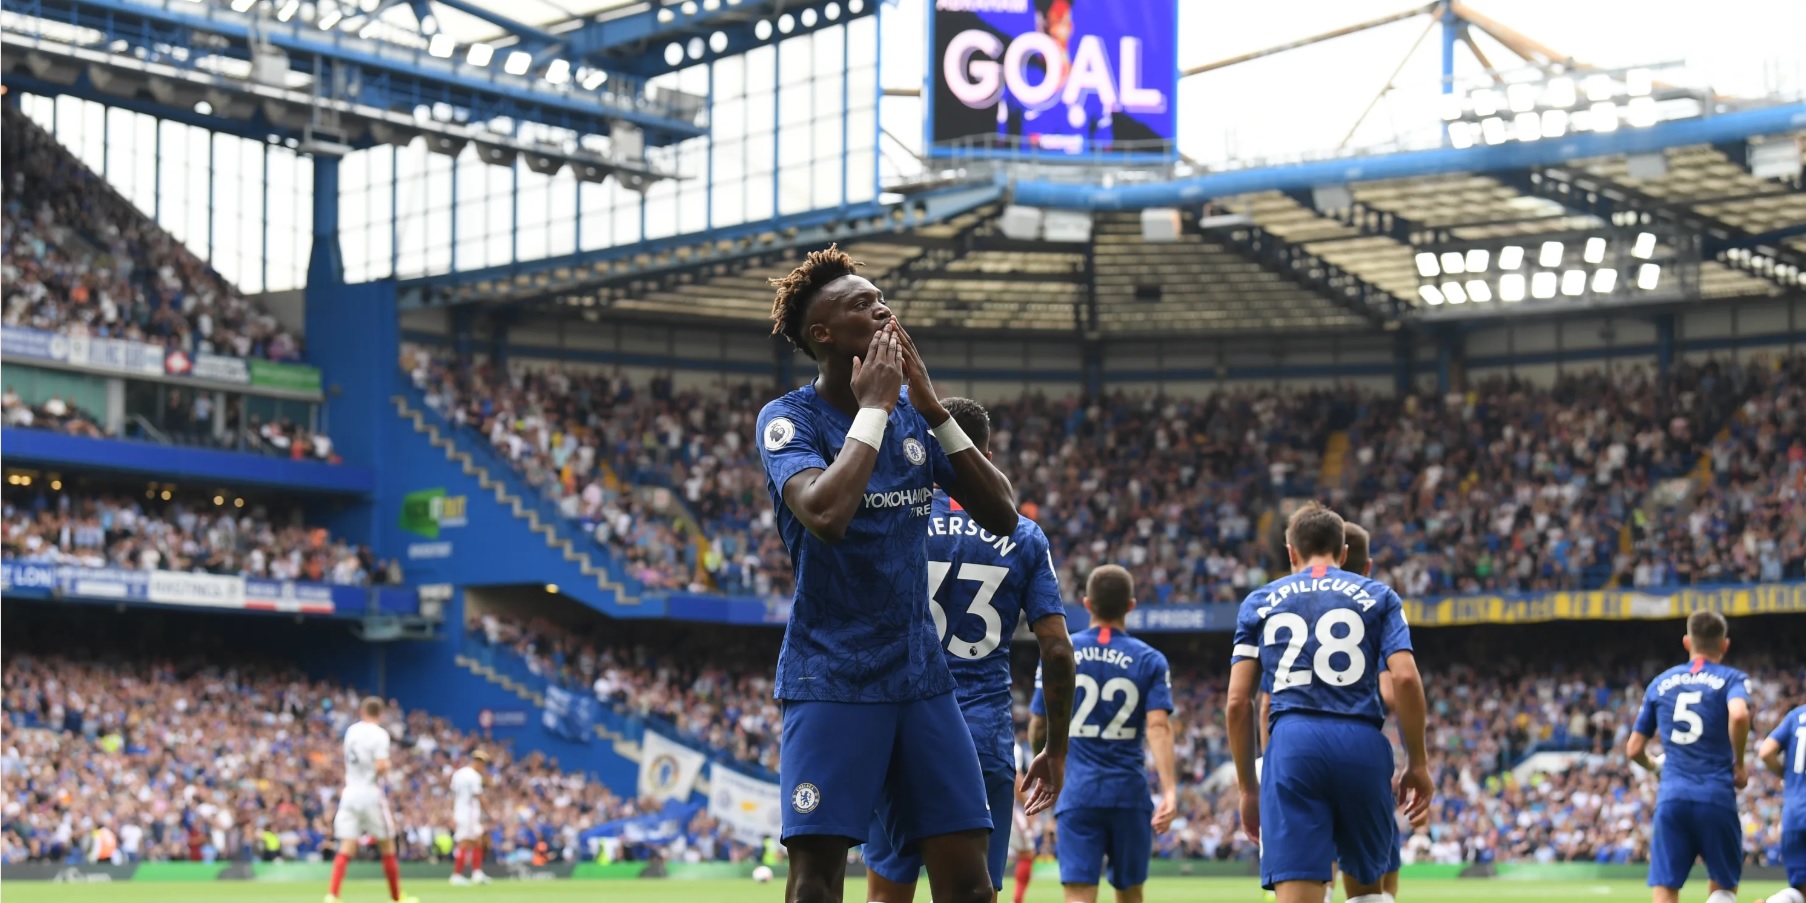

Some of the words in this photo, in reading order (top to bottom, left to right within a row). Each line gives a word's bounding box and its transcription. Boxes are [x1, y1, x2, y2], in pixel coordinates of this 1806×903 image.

[943, 29, 1166, 111] GOAL
[909, 504, 931, 518] RE
[928, 516, 1017, 557] ERSON
[1147, 610, 1205, 629] PRIDE
[1256, 578, 1377, 619] AZPILICUETA
[1074, 647, 1133, 669] PULISIC
[1264, 608, 1365, 693] 28
[1069, 673, 1139, 740] 22
[1671, 691, 1703, 745] 5
[1794, 726, 1806, 774] 1
